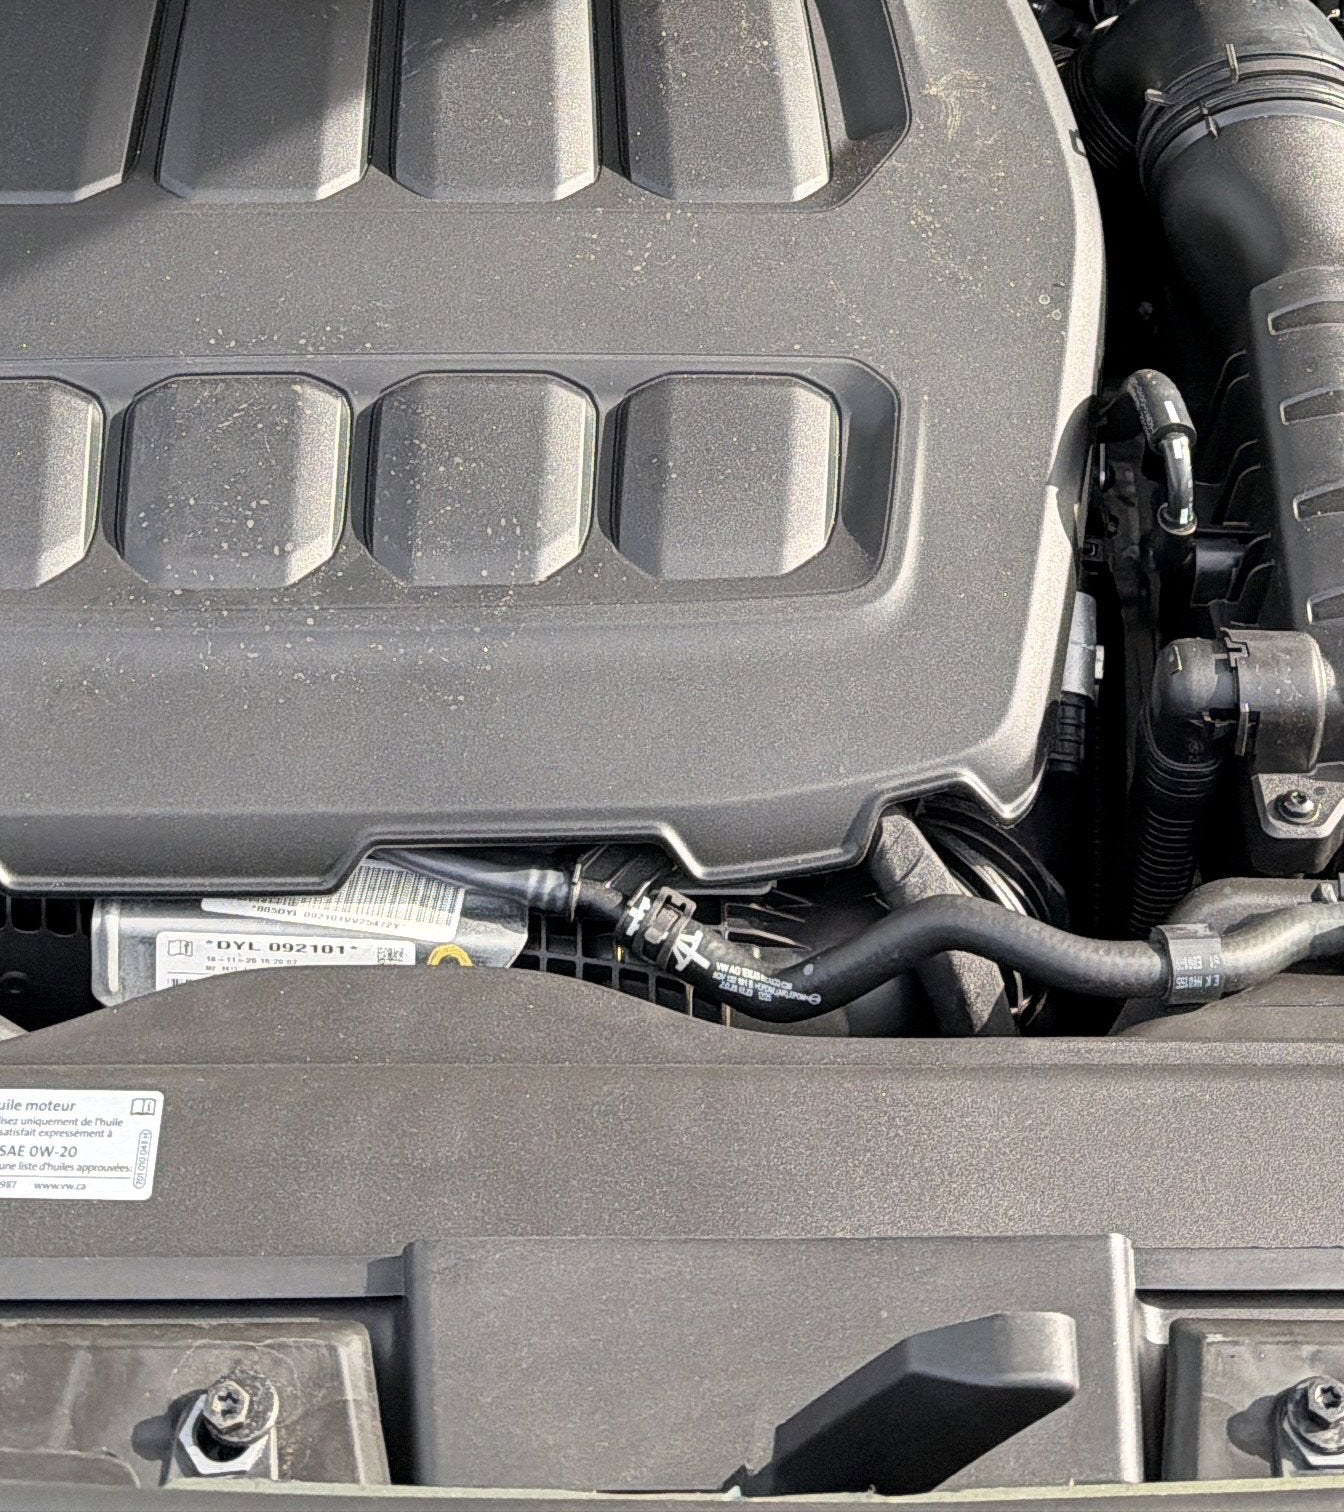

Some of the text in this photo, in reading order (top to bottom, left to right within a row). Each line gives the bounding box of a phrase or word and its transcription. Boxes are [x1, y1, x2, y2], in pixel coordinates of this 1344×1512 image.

[25, 1100, 77, 1112] moteur
[20, 1117, 79, 1130] uniquement
[80, 1118, 93, 1127] de
[94, 1118, 124, 1127] l'huile
[38, 1129, 102, 1139] expressément
[29, 1146, 78, 1158] 0W-20
[0, 1163, 17, 1171] une
[18, 1162, 38, 1171] liste
[39, 1163, 75, 1172] d'huiles
[34, 1182, 87, 1190] www.vw.ca
